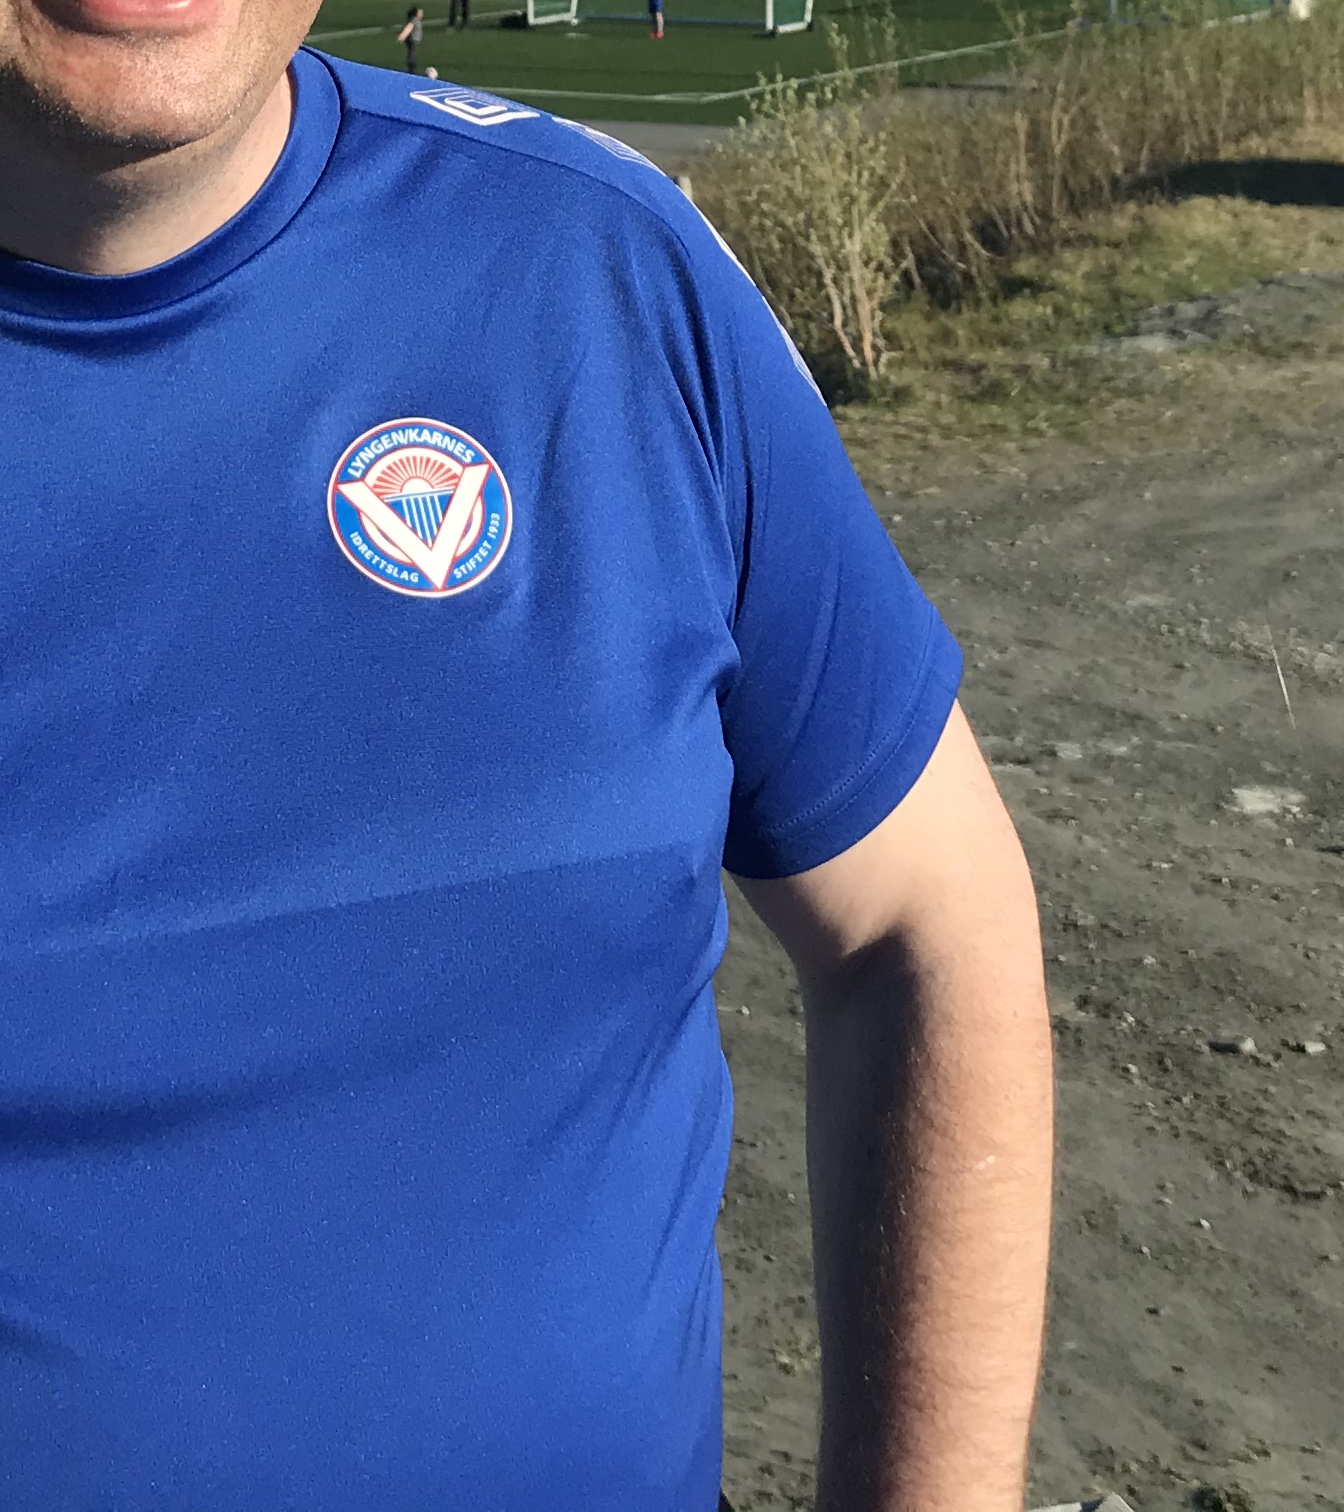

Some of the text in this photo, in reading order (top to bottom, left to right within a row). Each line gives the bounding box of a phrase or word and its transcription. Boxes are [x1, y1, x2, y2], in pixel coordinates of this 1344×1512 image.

[346, 427, 476, 479] LYNGEN/KARNES
[349, 531, 420, 584] IDRETTSLAG
[453, 512, 501, 580] STIFTET 1933
